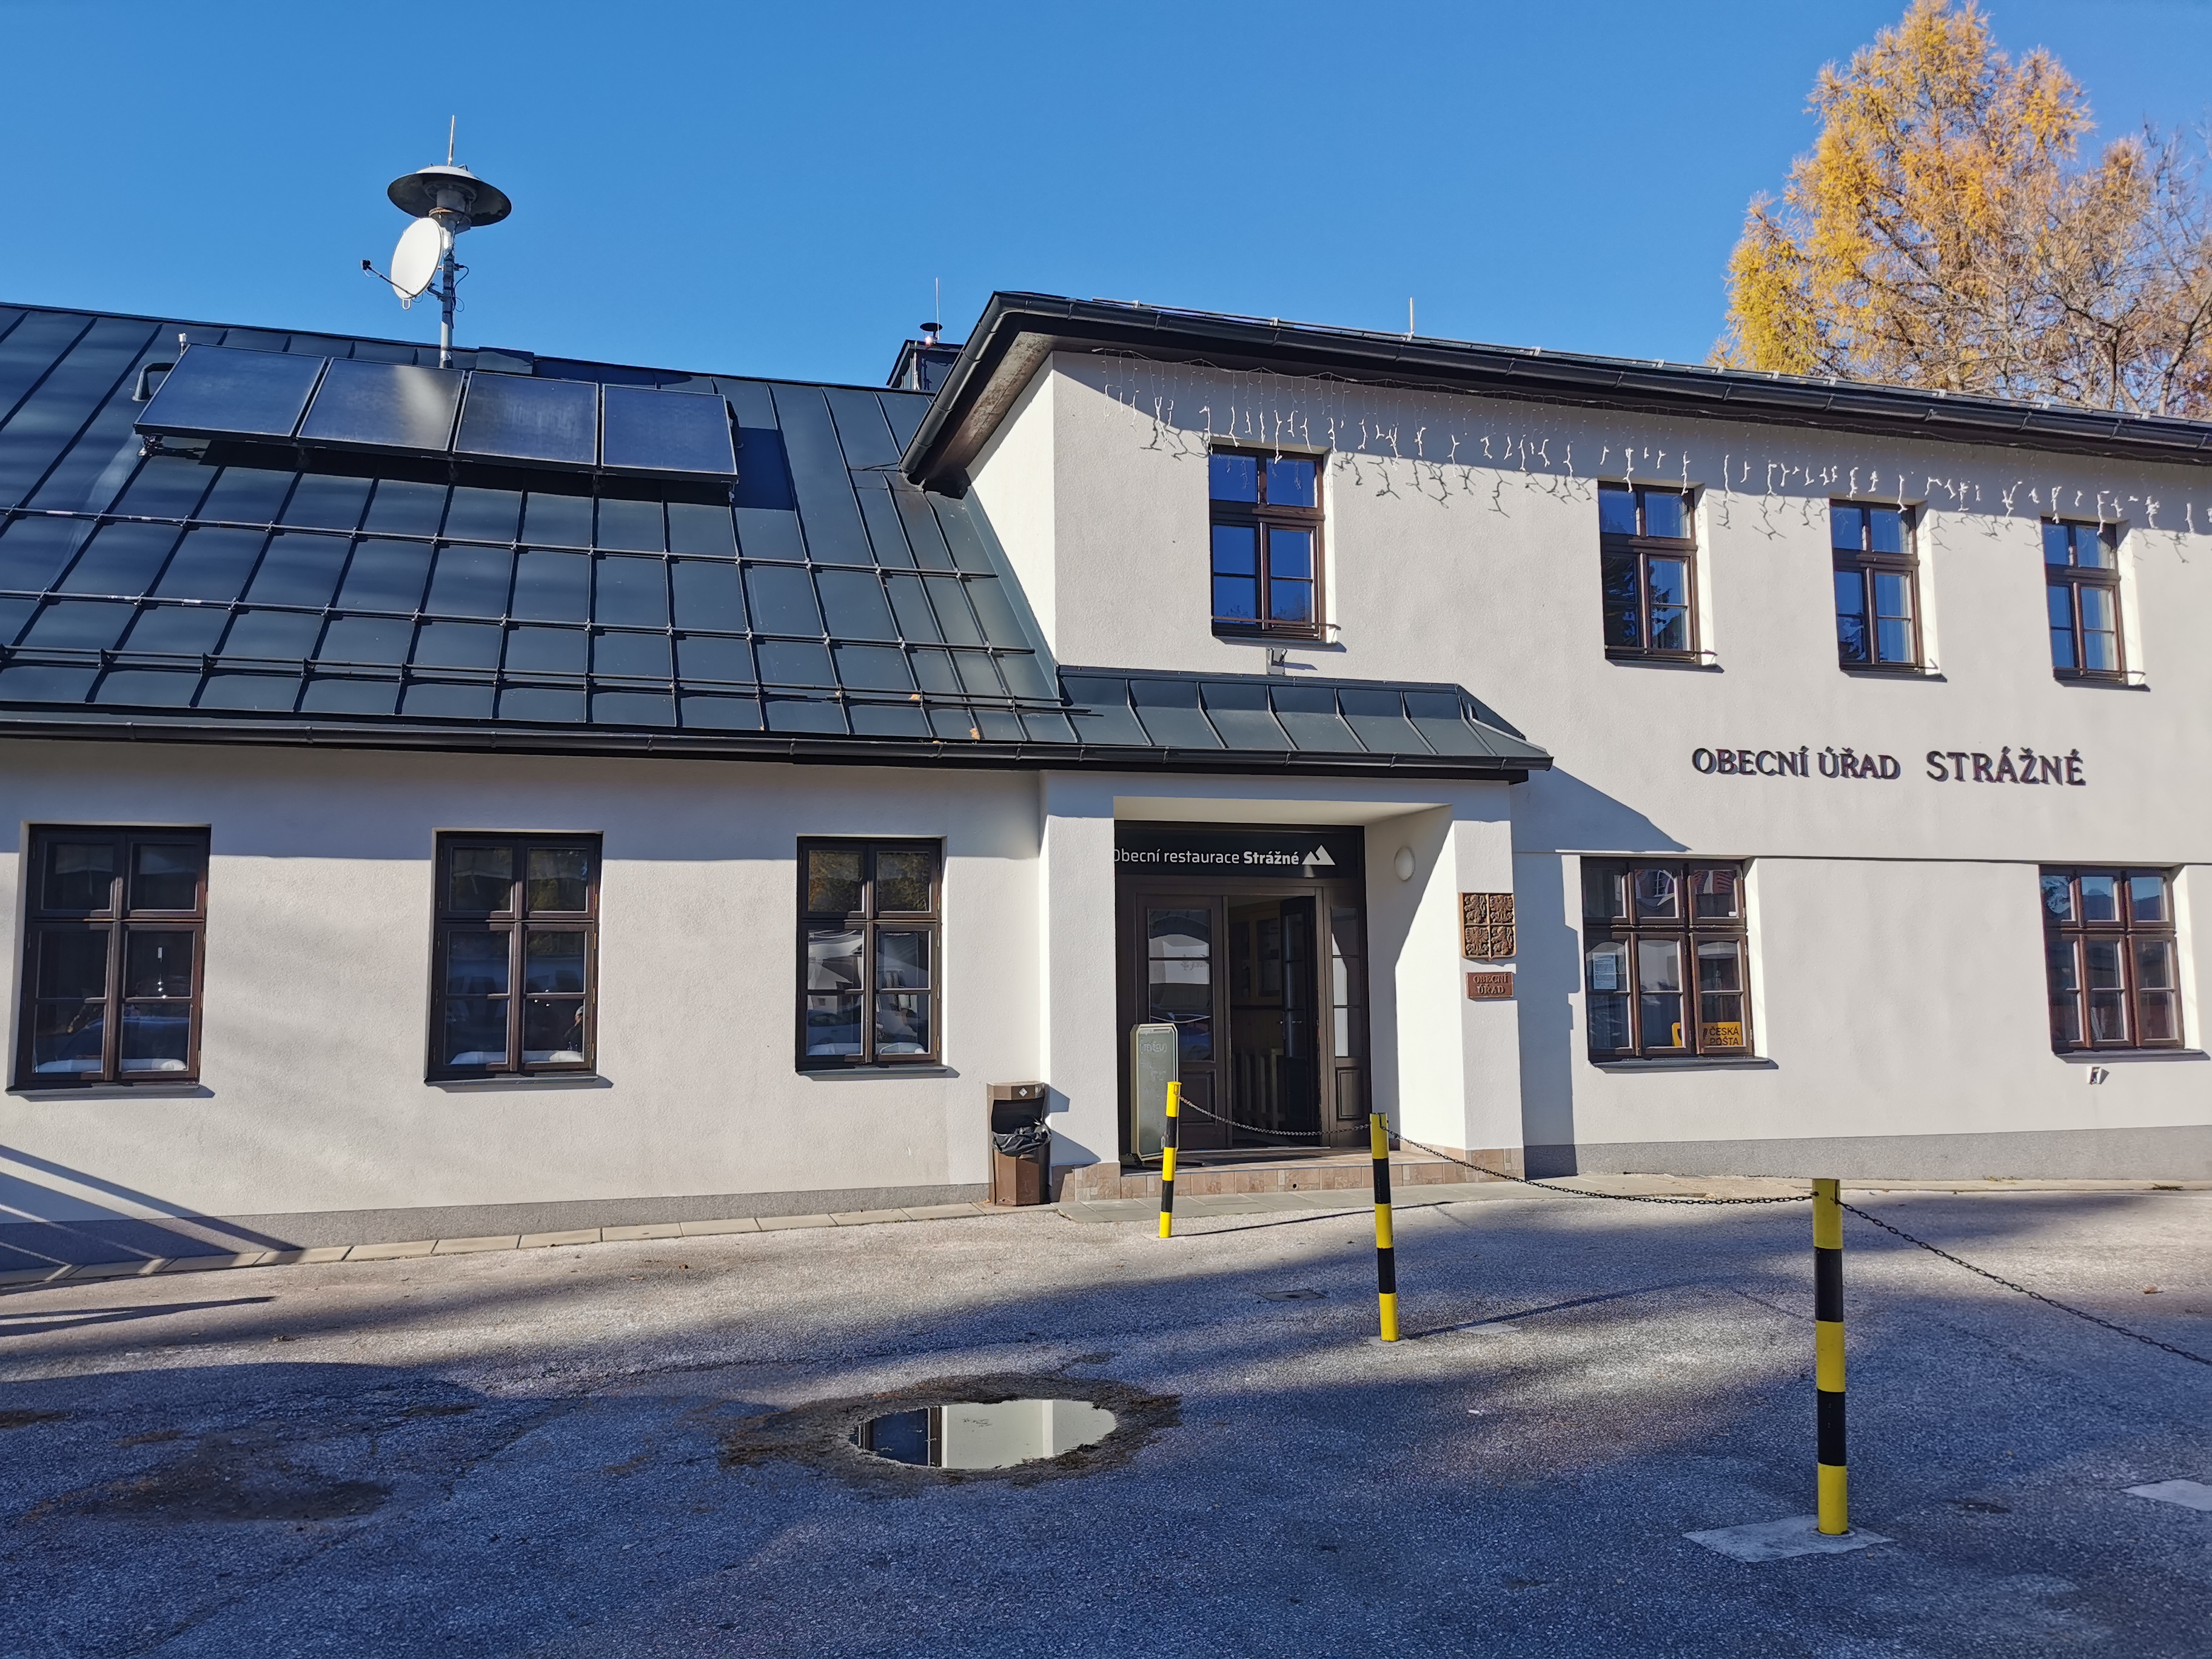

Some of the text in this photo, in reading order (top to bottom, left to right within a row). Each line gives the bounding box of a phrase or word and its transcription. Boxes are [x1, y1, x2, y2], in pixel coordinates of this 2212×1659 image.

[1692, 746, 2086, 786] OBECNÍ ÚŘAD STRÁŽNÉ
[1164, 850, 1239, 863] restaurace
[1243, 851, 1299, 865] Strážné
[1473, 973, 1508, 984] OBECNÍ
[1476, 984, 1505, 994] ÚŘAD
[1709, 1026, 1740, 1036] ČESKÁ
[1709, 1036, 1739, 1045] POŠTA
